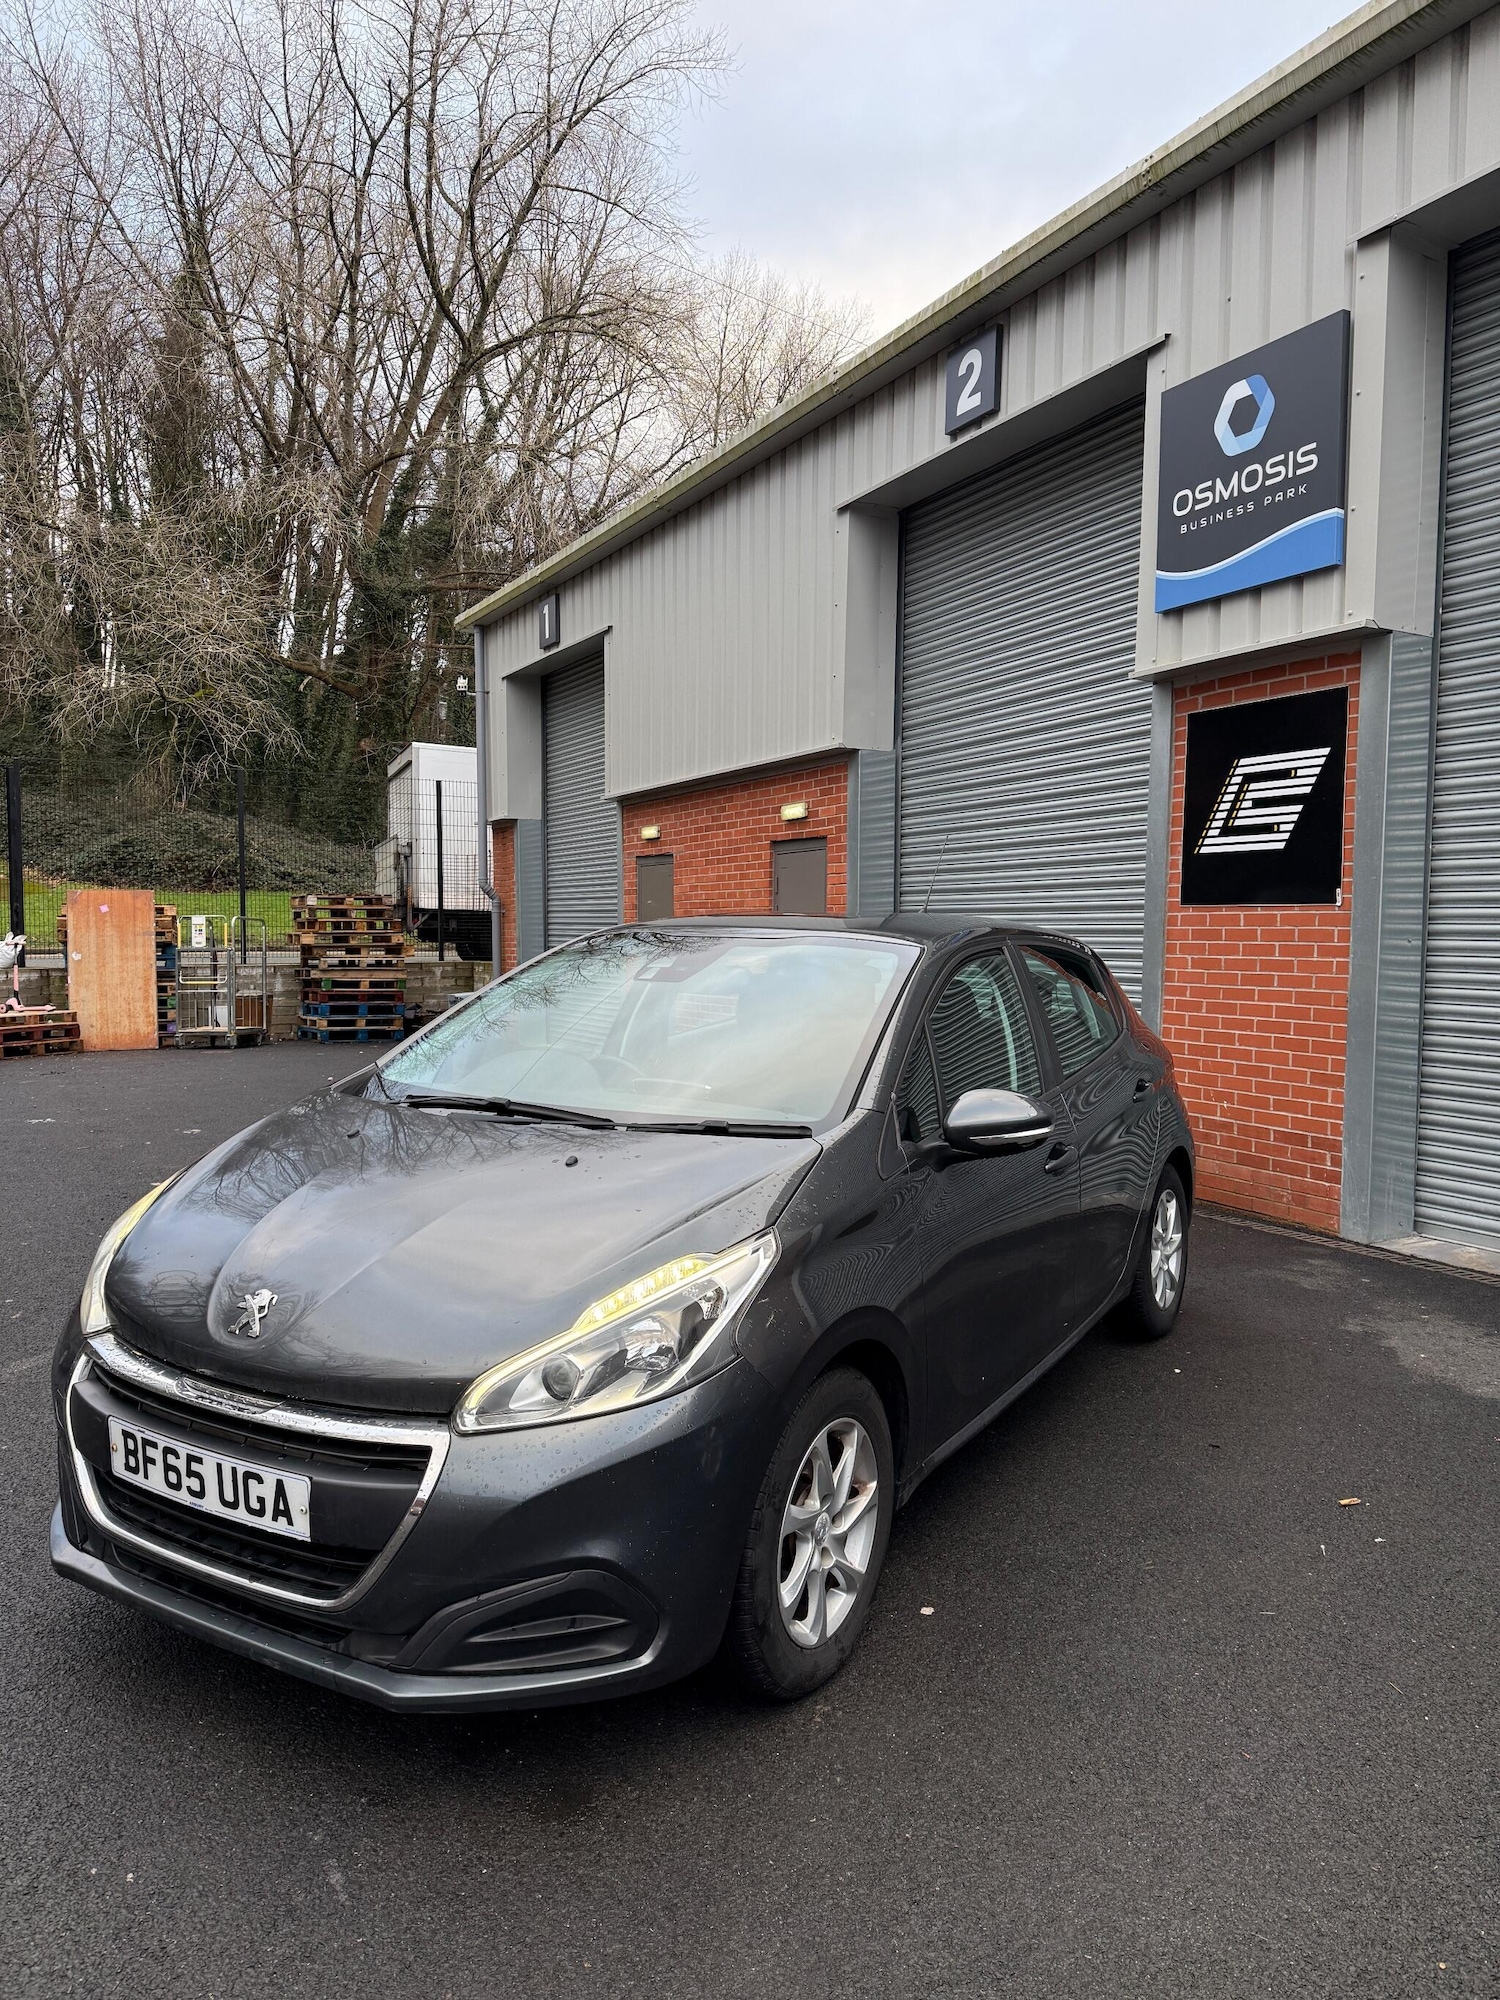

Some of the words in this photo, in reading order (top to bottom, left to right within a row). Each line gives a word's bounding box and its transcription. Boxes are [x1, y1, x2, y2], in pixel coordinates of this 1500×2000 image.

[956, 348, 983, 417] 2
[1172, 441, 1319, 518] OSMOSIS
[1180, 501, 1255, 534] BUSINESS
[1264, 483, 1308, 507] PARK
[542, 603, 550, 640] 1
[121, 1428, 206, 1500] BF65
[216, 1461, 294, 1527] UGA
